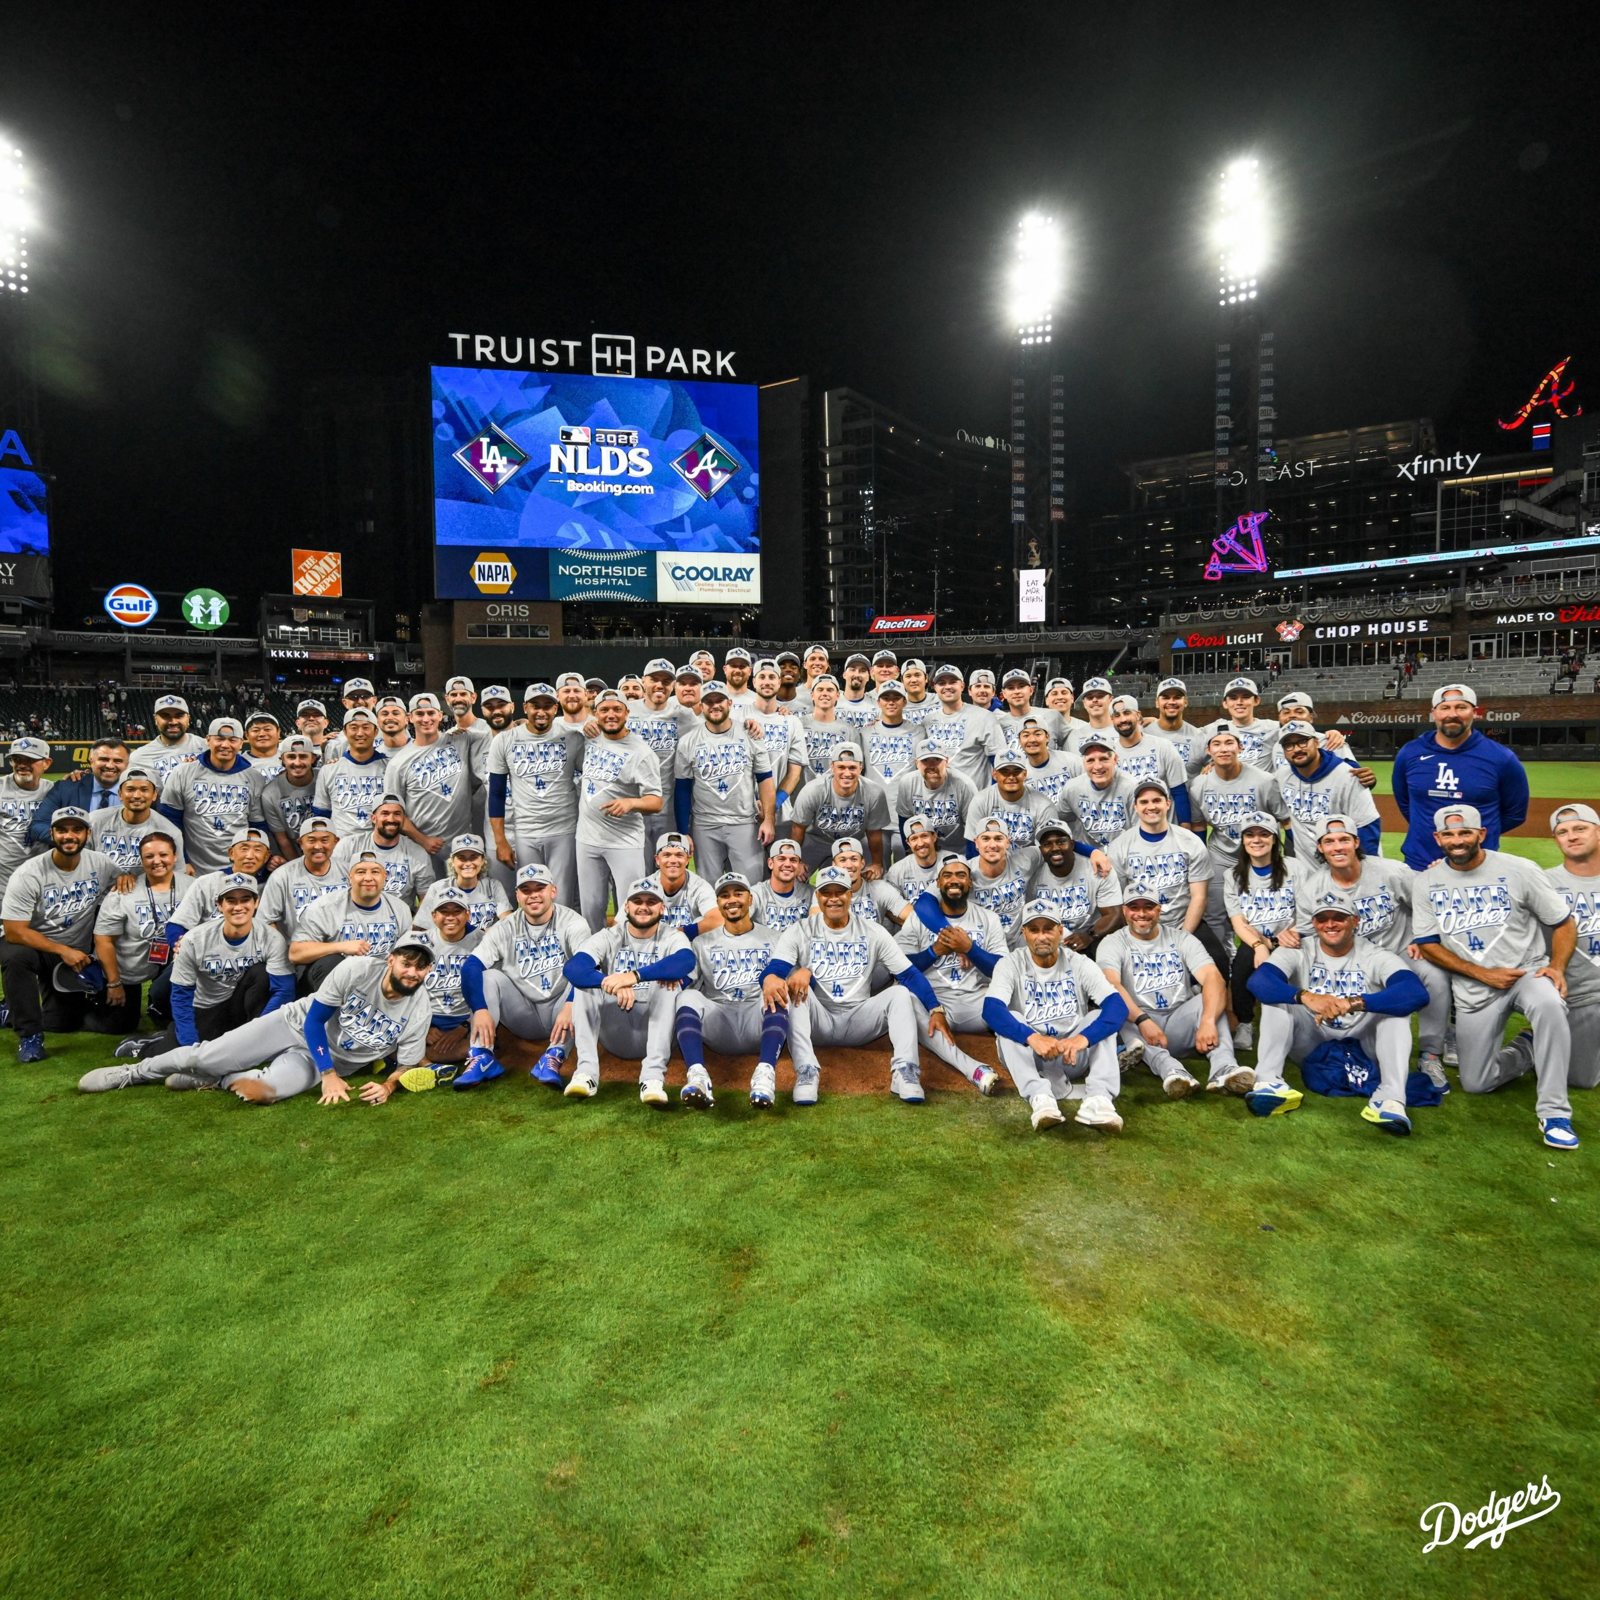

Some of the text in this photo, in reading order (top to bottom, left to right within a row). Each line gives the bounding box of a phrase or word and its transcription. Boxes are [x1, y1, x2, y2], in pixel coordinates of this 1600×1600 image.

[448, 332, 737, 377] TRUIST PARK
[549, 444, 653, 477] NLDS
[1396, 451, 1481, 481] xfinity
[567, 480, 654, 496] Booking.com
[294, 552, 341, 595] HOME
[298, 555, 318, 574] THE
[478, 564, 510, 582] NAPA
[559, 565, 647, 576] NORTHSIDE
[671, 566, 755, 581] COOLRAY
[312, 569, 342, 595] DEPOT
[575, 578, 632, 586] HOSPITAL
[108, 598, 152, 612] Gulf
[486, 604, 530, 616] ORIS
[874, 618, 927, 630] RaceTrac
[1496, 613, 1534, 624] MADE
[1538, 612, 1555, 621] TO
[1315, 620, 1429, 638] CHOP HOUSE
[1187, 633, 1263, 648] Coors LIGHT
[1351, 712, 1422, 724] Coors LIGHT
[1486, 711, 1521, 722] CHOP
[511, 743, 567, 763] TAKE
[870, 735, 914, 754] TAKE
[409, 745, 462, 774] TAKE
[584, 745, 626, 774] TAKE
[695, 744, 748, 768] TAKE
[869, 749, 911, 765] October
[418, 761, 463, 789] October
[514, 758, 565, 779] October
[701, 758, 745, 780] October
[1435, 763, 1459, 790] LA
[193, 782, 249, 804] TAKE
[1204, 793, 1257, 813] TAKE
[2, 800, 43, 816] TAK
[194, 798, 248, 815] October
[818, 806, 864, 821] TAKE
[912, 800, 957, 817] TAKE
[1078, 801, 1124, 820] TAKE
[101, 836, 141, 856] TAK
[1128, 853, 1188, 874] TAKE
[43, 878, 100, 906] TAKE
[975, 878, 1025, 905] TAKE
[1430, 884, 1511, 916] TAKE
[135, 902, 181, 925] TAK
[766, 904, 809, 924] TAKE
[1242, 901, 1296, 924] October
[1437, 903, 1511, 934] October
[340, 922, 398, 941] TAKE
[1466, 932, 1485, 950] LA
[710, 949, 770, 971] TAKE
[810, 941, 868, 964] TAKE
[812, 959, 866, 980] October
[1131, 951, 1183, 976] TAKE
[831, 981, 844, 997] LA
[1310, 965, 1367, 994] TAKE
[1024, 977, 1076, 1006] TAKE
[1155, 992, 1168, 1009] LA
[343, 992, 404, 1040] TAKE
[1024, 998, 1077, 1024] October
